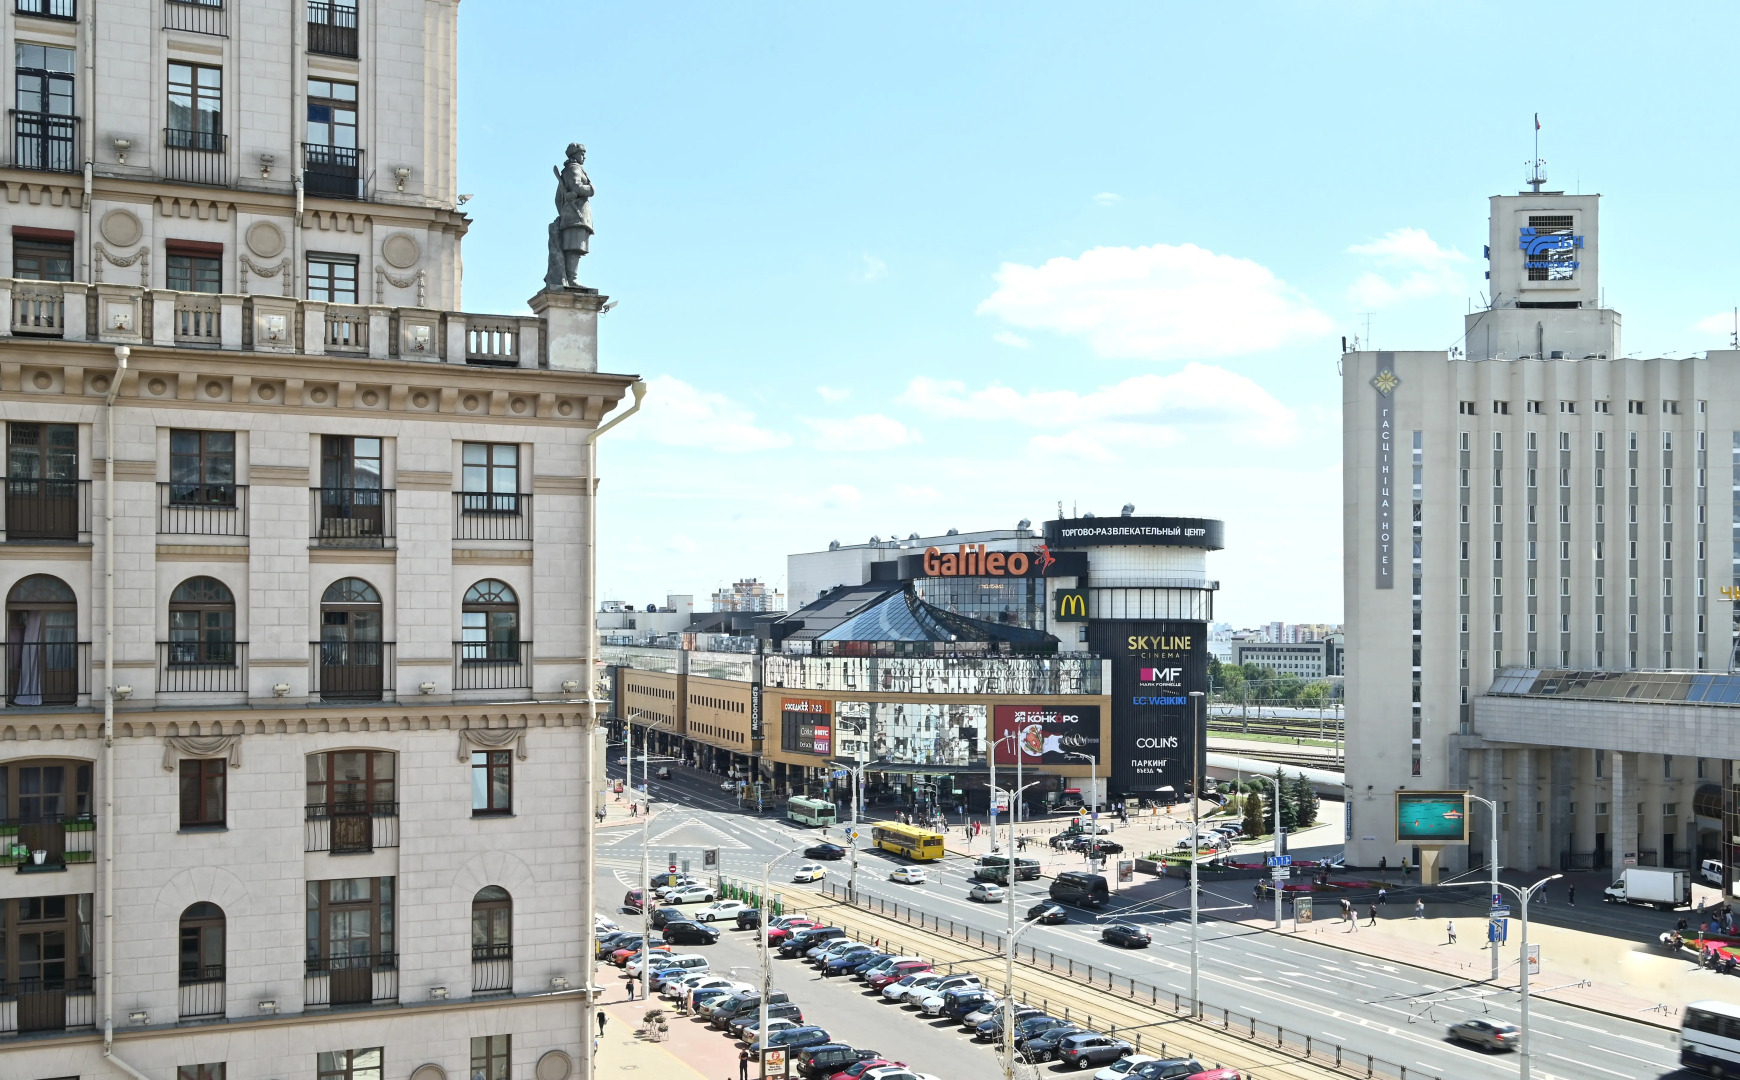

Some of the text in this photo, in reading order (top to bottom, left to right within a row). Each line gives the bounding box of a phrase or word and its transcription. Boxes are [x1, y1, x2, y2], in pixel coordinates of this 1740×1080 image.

[1381, 408, 1390, 508] ГАСЦІНІЦА
[1062, 526, 1206, 537] ТОРГОВО-РАЗВЛЕКАТЕЛЬНЫЙ ЦЕНТР
[1381, 522, 1390, 576] HOTEL
[923, 544, 1029, 577] Galileo
[1127, 635, 1192, 650] SKYLINE
[1152, 667, 1183, 681] MF
[1136, 736, 1178, 748] COLIN'S
[1131, 759, 1168, 767] ПАРКИНГ
